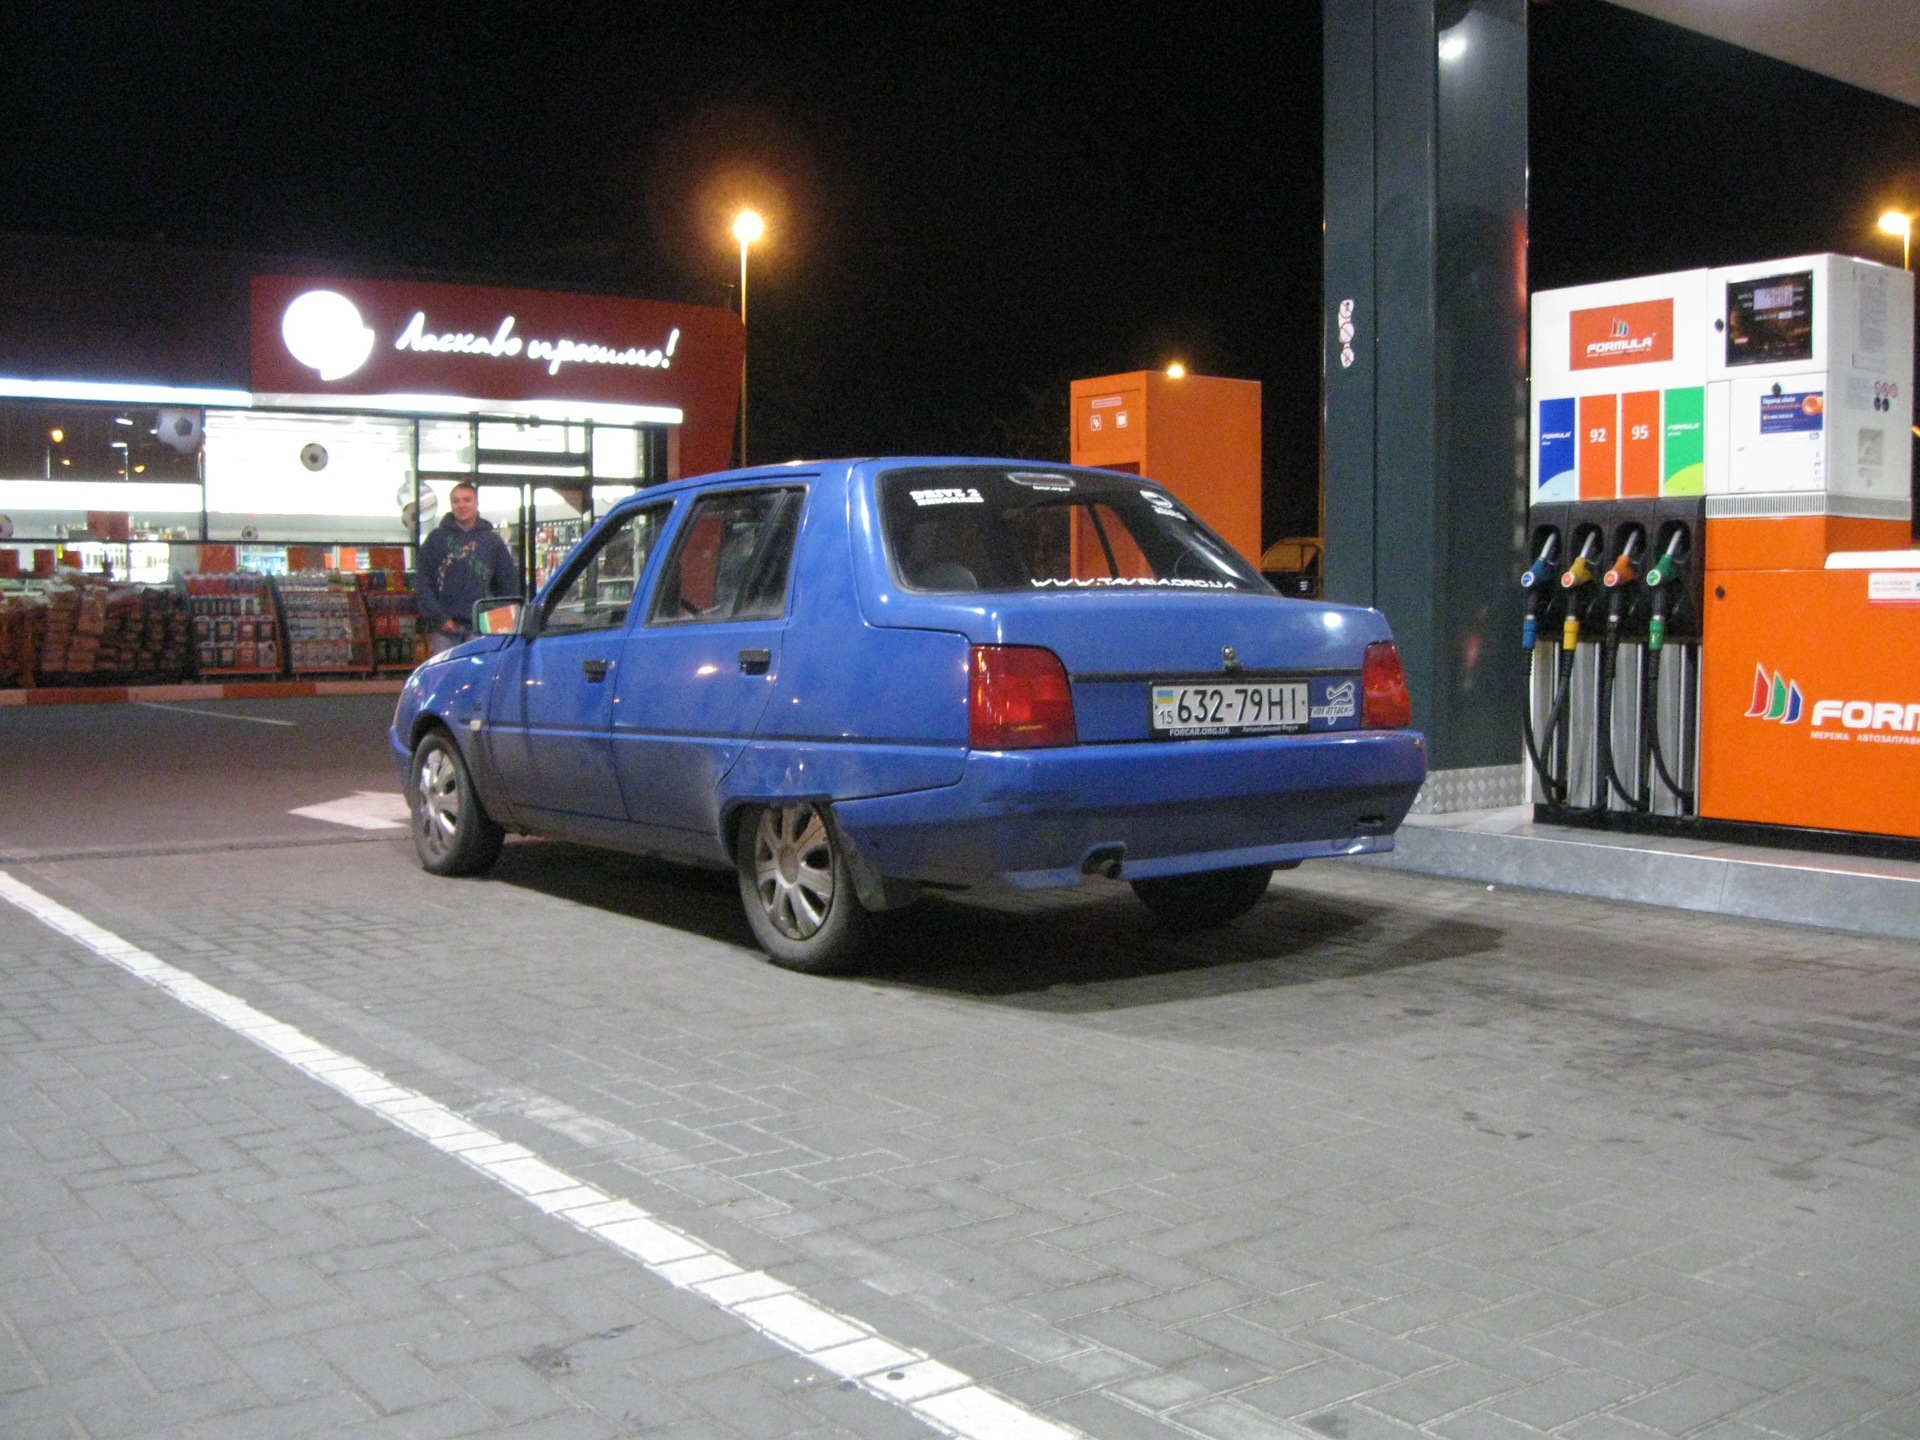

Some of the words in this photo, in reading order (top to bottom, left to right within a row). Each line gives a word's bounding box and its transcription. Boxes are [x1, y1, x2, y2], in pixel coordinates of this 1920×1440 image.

[395, 311, 523, 357] Ласкаво
[527, 328, 680, 375] просимо!
[1586, 337, 1652, 354] FORMULA
[1541, 431, 1572, 440] FORMULA
[1589, 428, 1606, 443] 92
[1631, 425, 1649, 441] 95
[966, 488, 982, 498] 2
[1158, 710, 1174, 725] 15
[1169, 727, 1230, 737] FORCAR.ORG.UA
[1811, 731, 1849, 741] МЕРЕЖА
